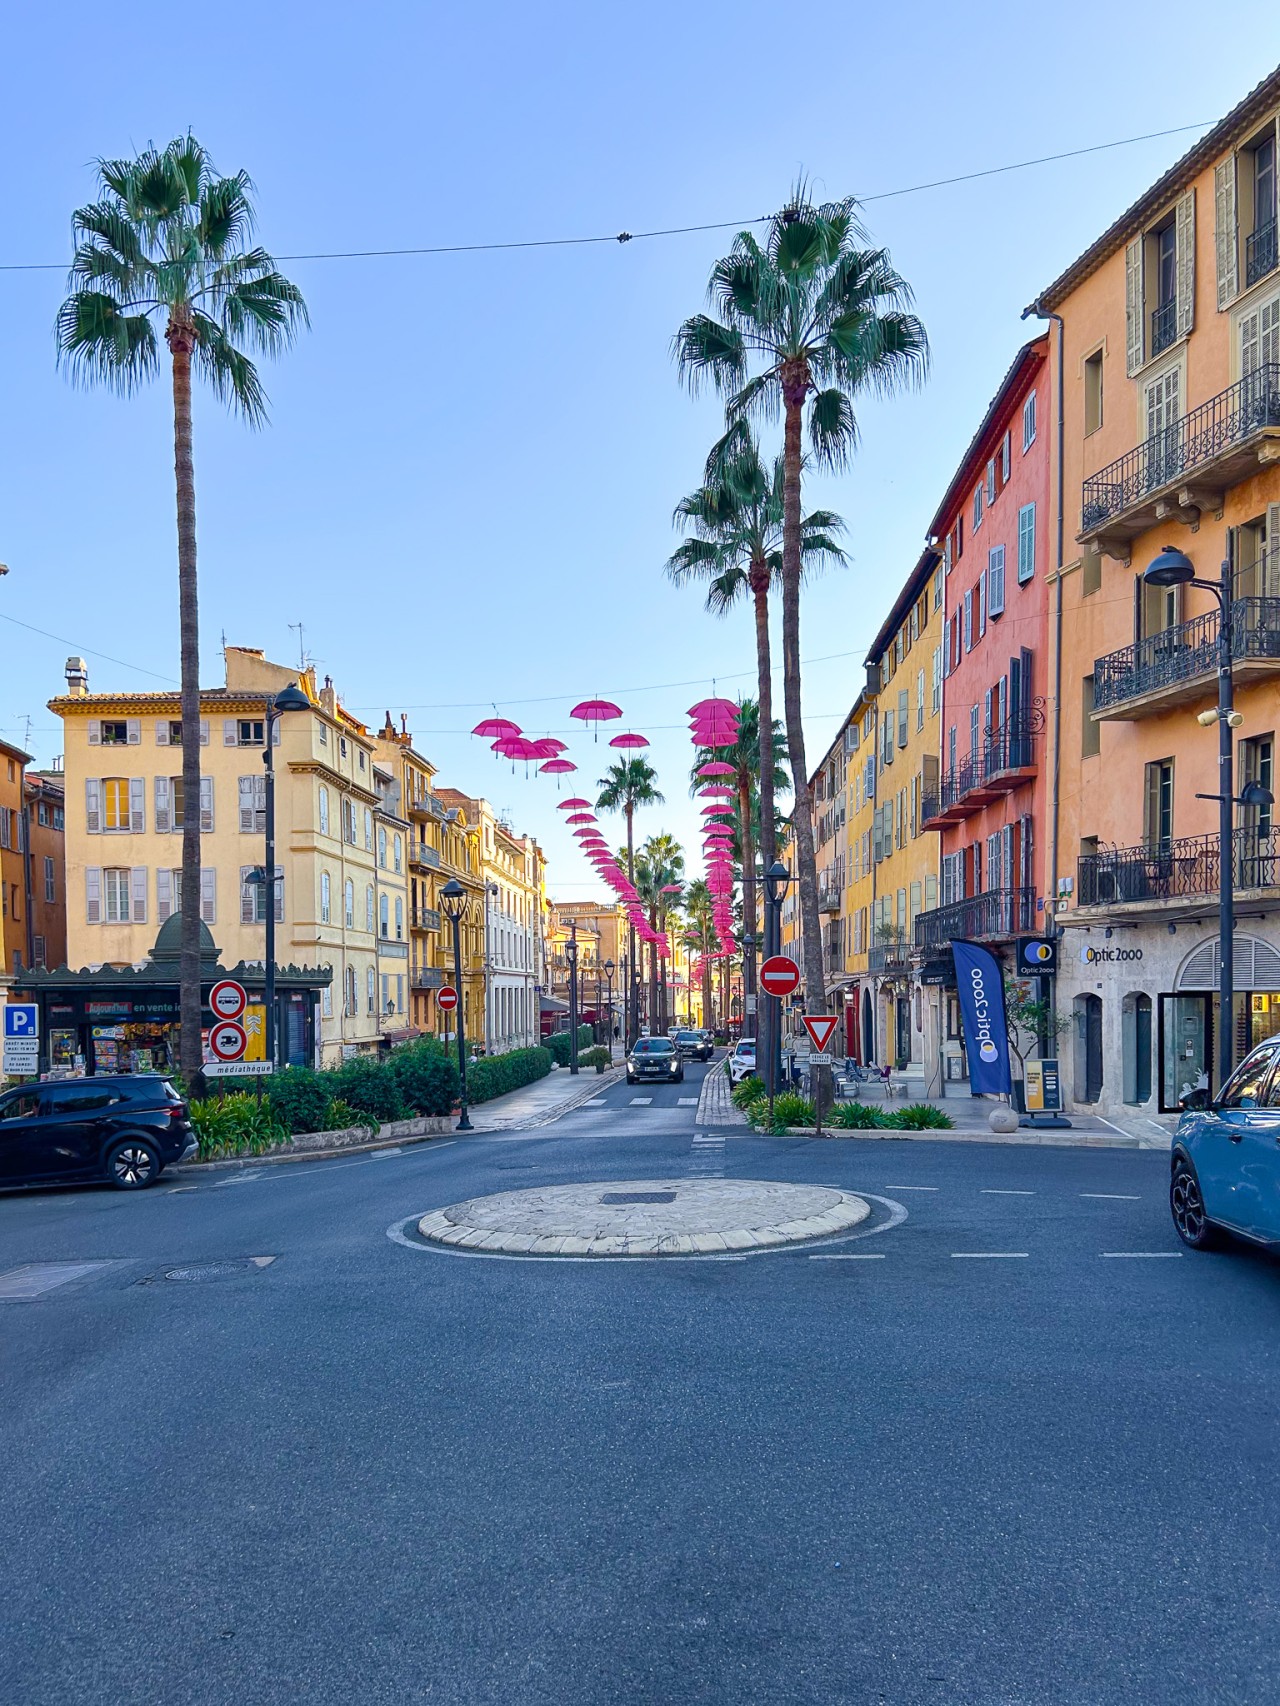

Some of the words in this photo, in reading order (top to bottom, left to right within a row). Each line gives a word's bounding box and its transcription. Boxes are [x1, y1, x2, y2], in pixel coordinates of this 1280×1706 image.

[1087, 946, 1115, 966] Optic
[1115, 947, 1143, 961] 2000
[1020, 967, 1038, 975] Optic
[89, 1003, 128, 1015] Aujourd'hui
[134, 1004, 145, 1012] en
[147, 1003, 173, 1012] vente
[13, 1011, 28, 1031] P
